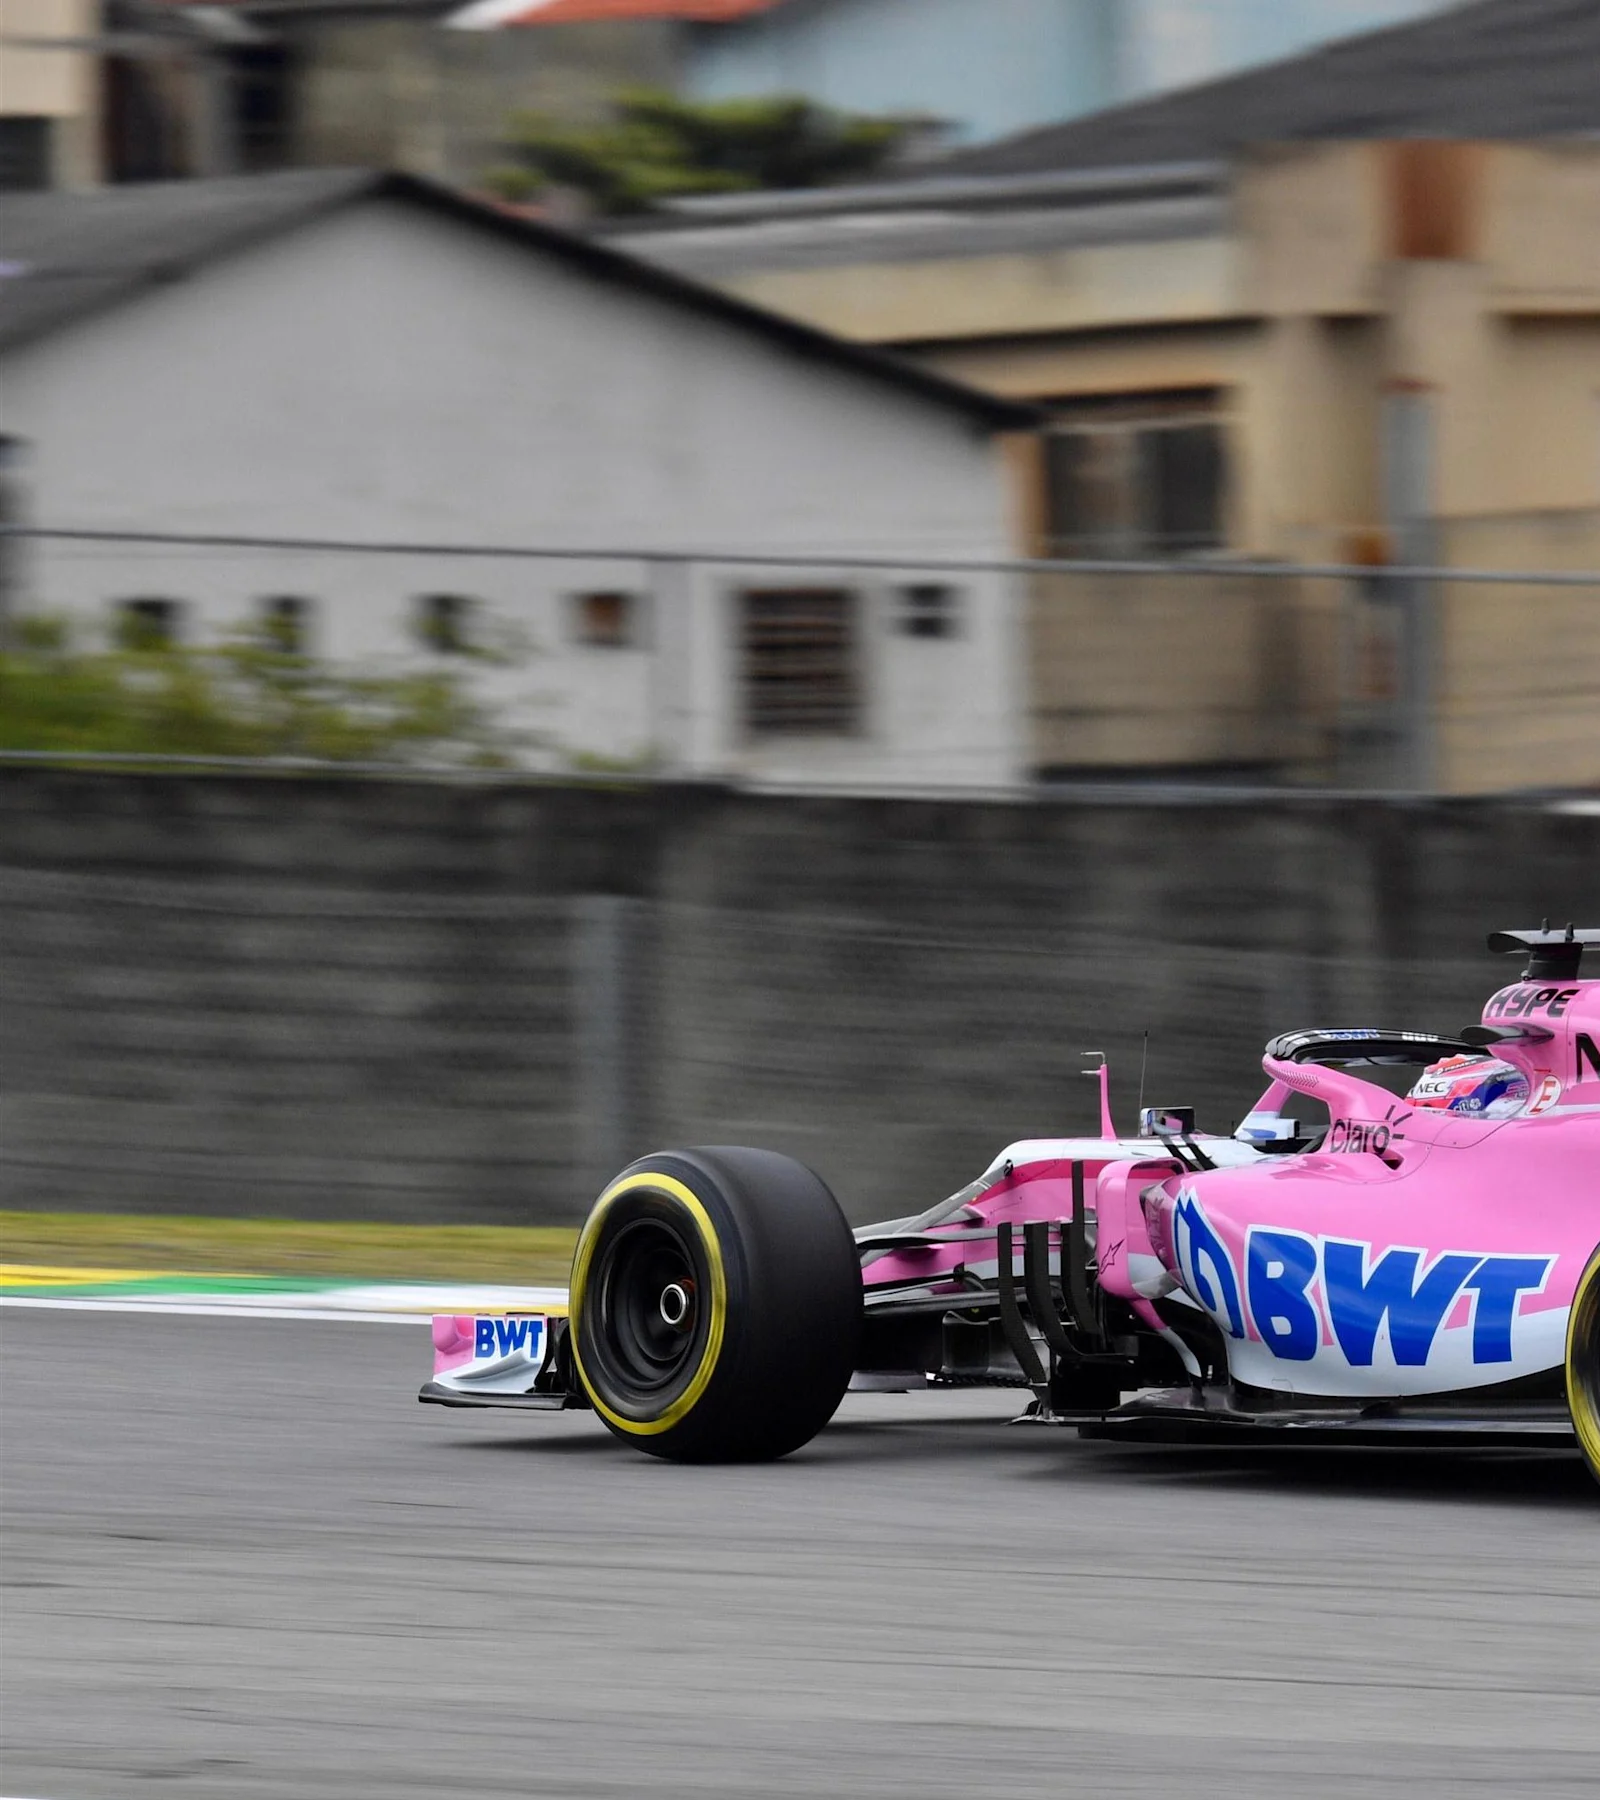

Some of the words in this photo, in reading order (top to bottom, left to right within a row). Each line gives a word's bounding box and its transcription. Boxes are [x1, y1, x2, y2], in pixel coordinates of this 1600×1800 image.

[1485, 988, 1580, 1018] HYPE
[1417, 1081, 1446, 1094] NEC
[1330, 1119, 1390, 1154] Claro
[1248, 1232, 1548, 1366] BWT
[475, 1319, 543, 1358] BWT
